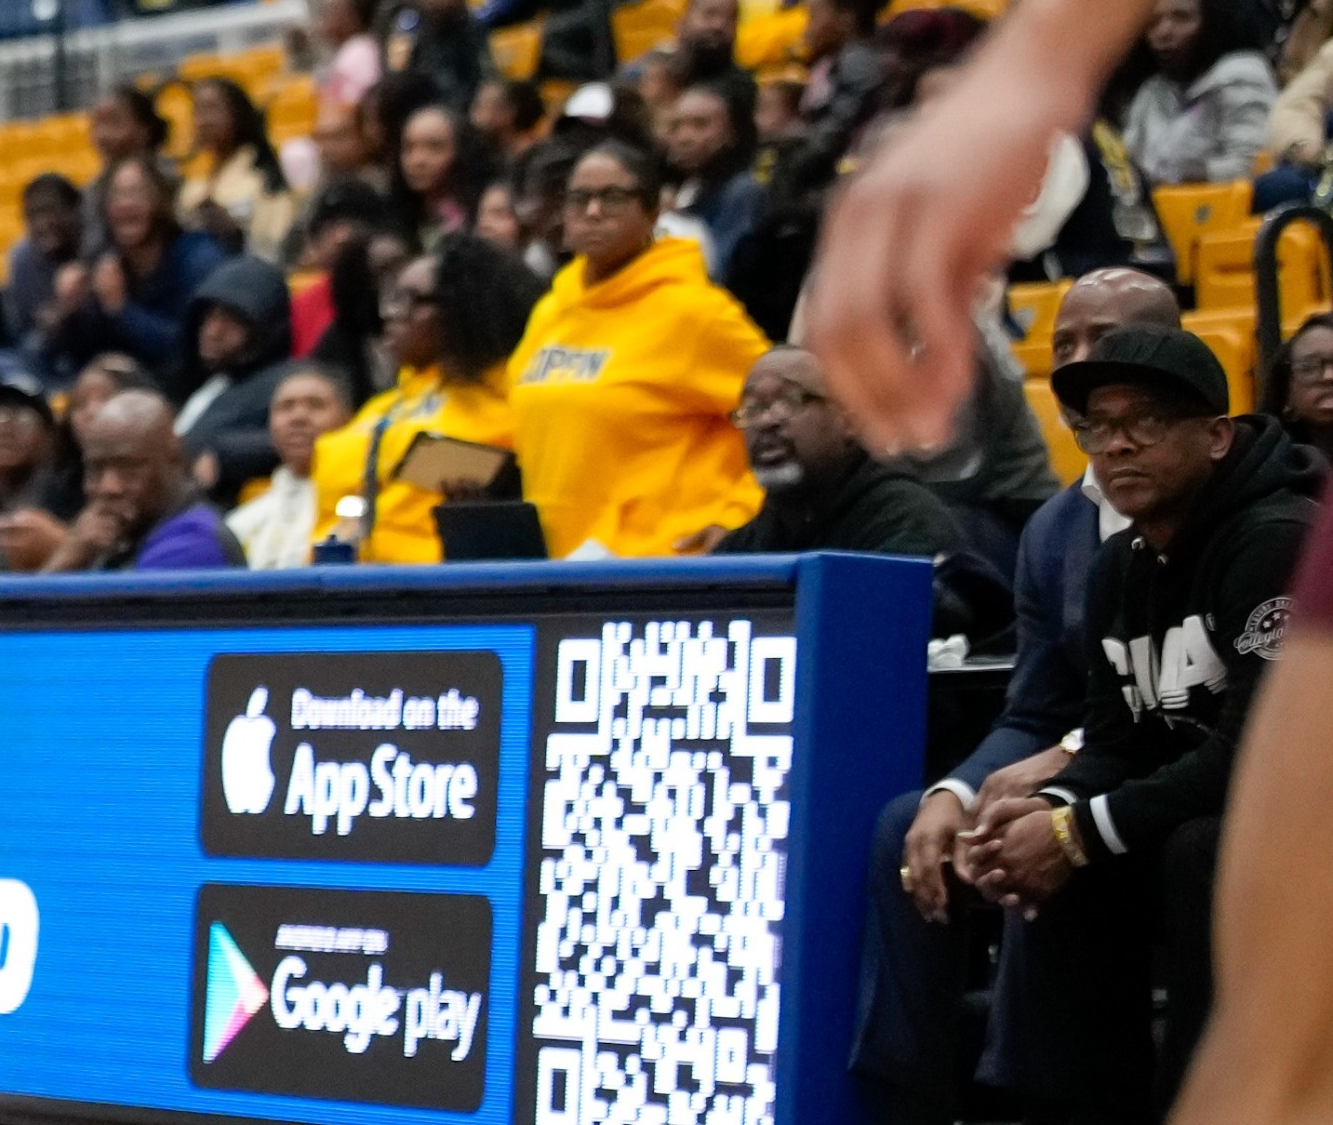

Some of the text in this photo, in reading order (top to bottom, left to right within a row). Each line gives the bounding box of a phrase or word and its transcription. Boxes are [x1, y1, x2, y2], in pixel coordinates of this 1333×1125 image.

[290, 687, 481, 731] Download on the
[283, 742, 478, 836] App Store
[270, 955, 482, 1062] Google play
